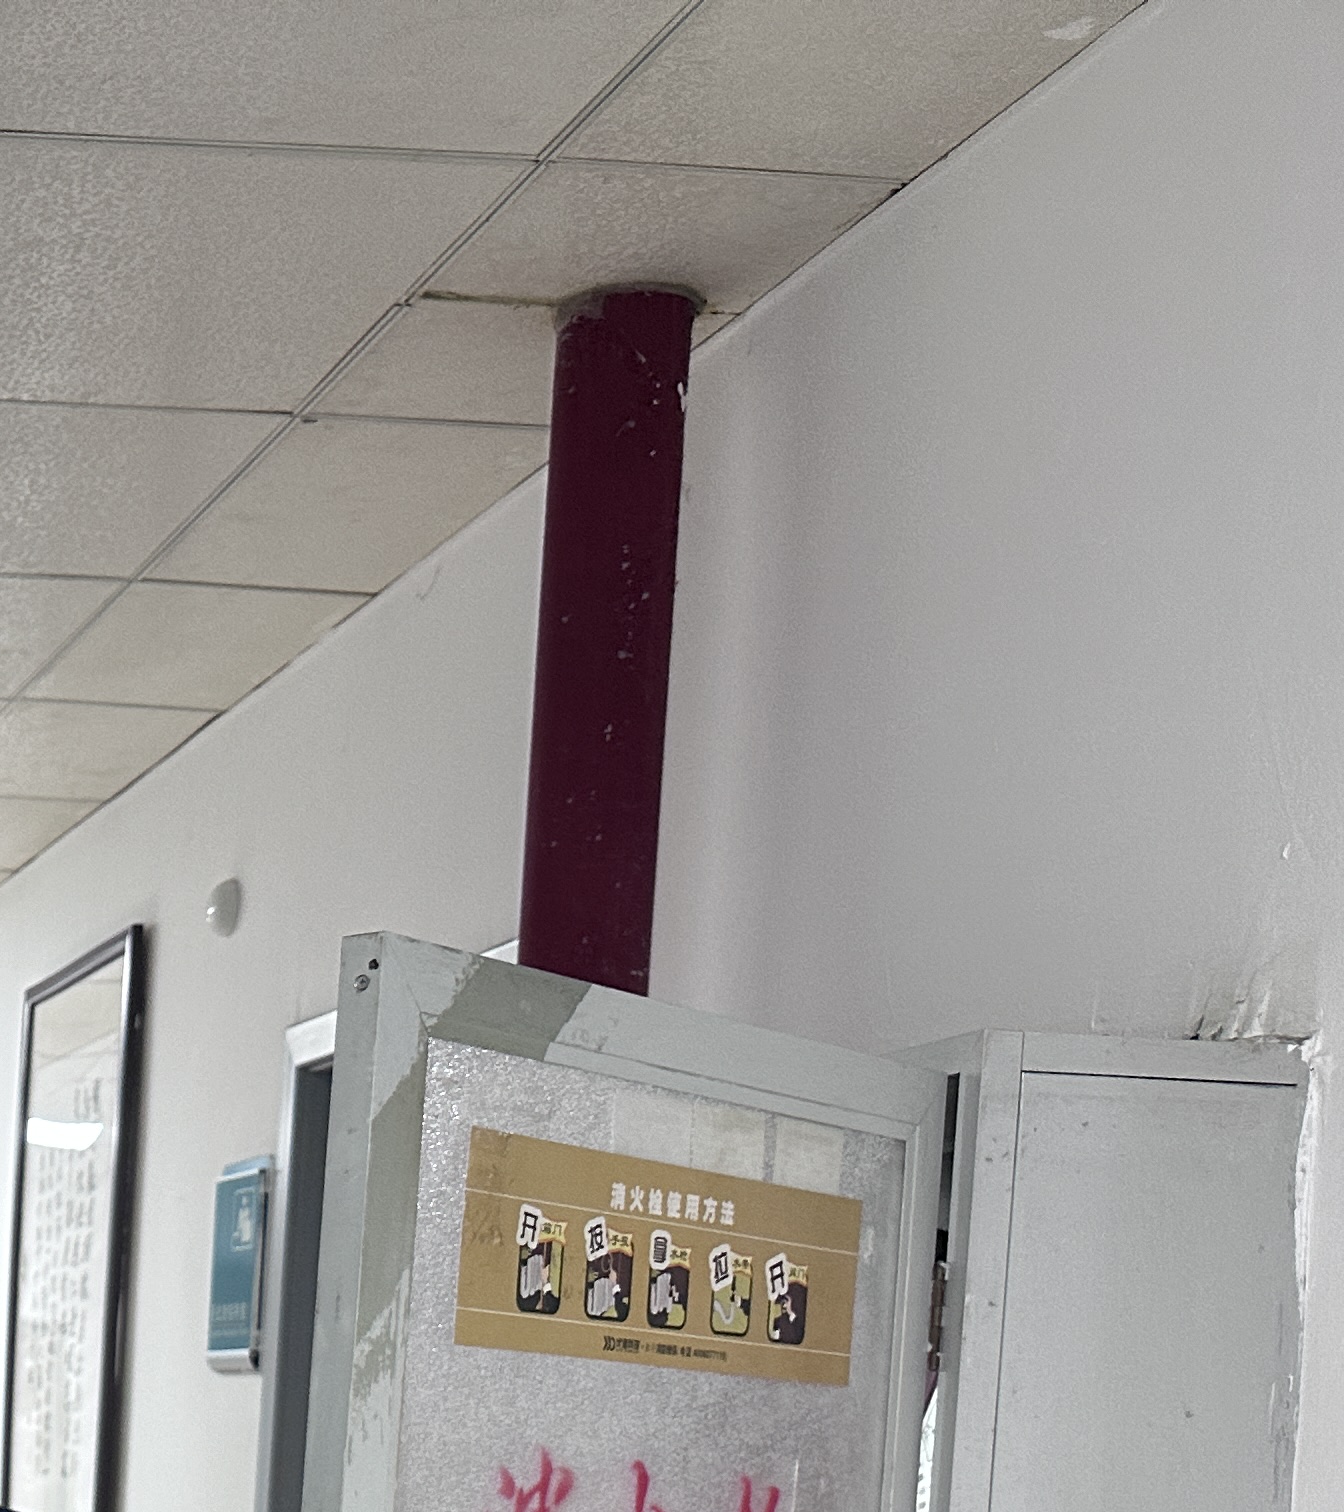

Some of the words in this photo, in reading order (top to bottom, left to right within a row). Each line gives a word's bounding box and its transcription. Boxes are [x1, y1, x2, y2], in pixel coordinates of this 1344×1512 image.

[609, 1181, 736, 1226] 消火栓使用方法
